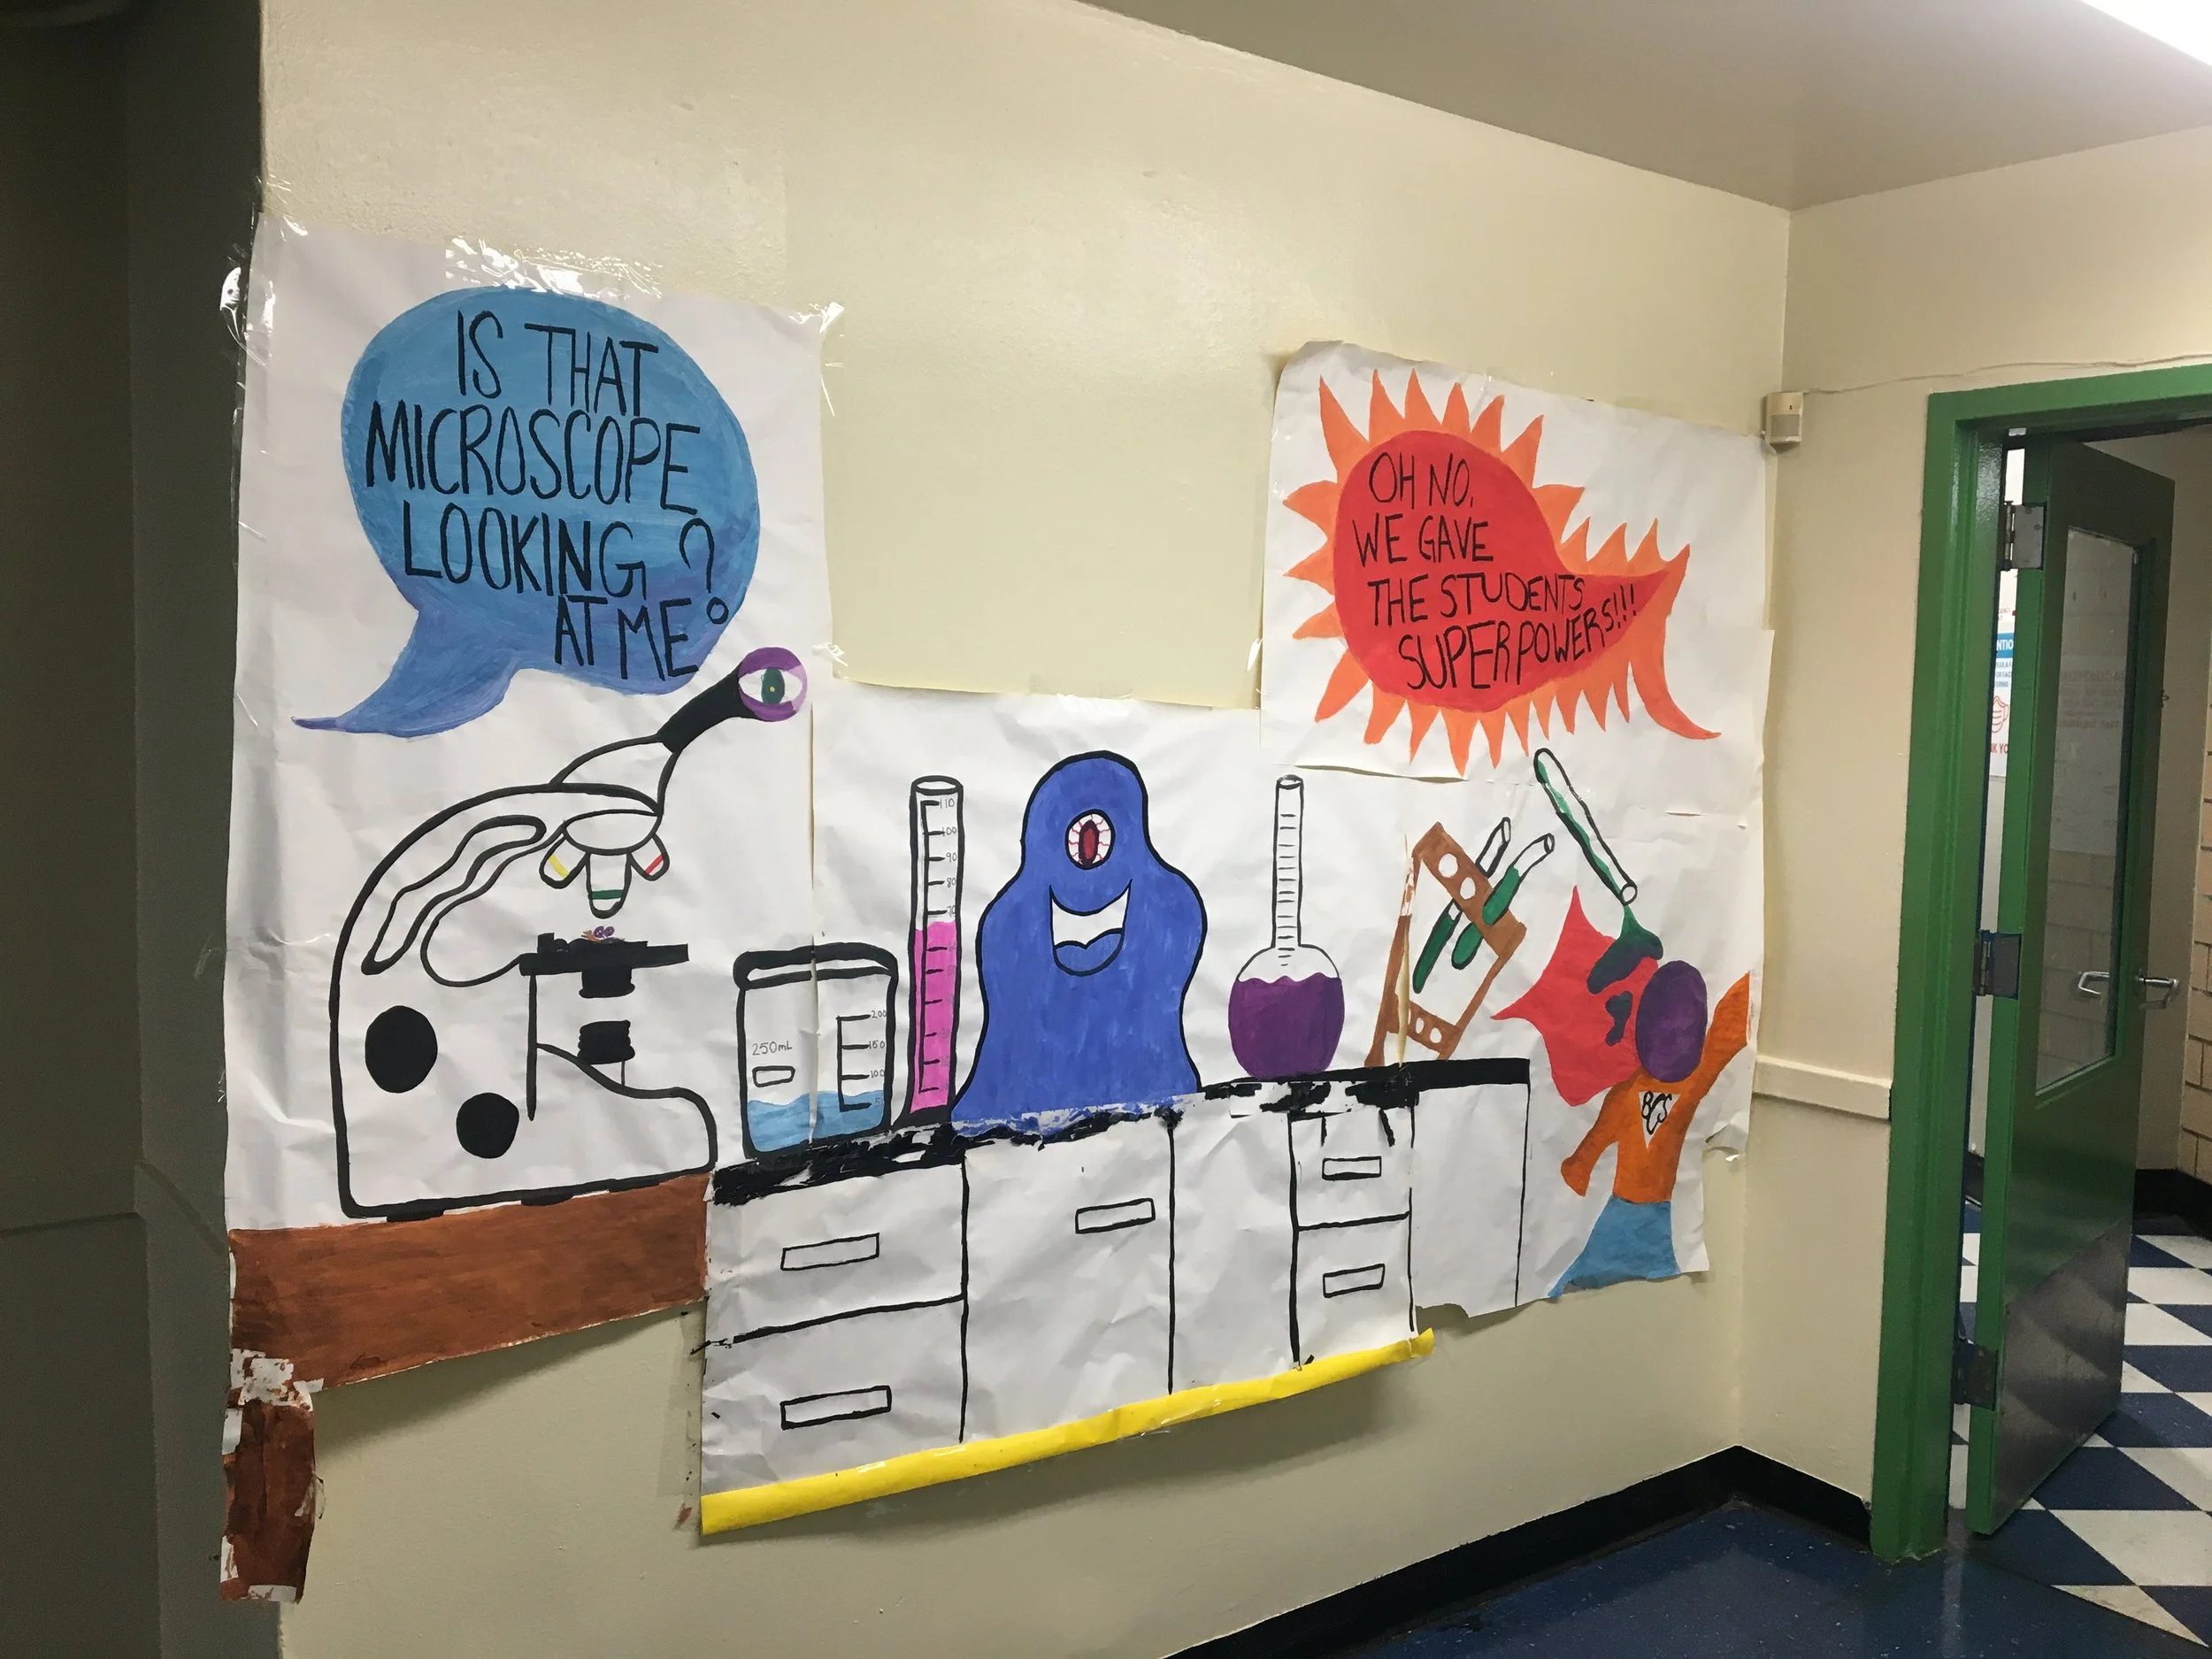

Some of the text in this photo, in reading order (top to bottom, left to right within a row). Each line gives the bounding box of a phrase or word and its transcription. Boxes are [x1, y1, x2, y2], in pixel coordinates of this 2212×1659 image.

[457, 309, 659, 417] IS THAT
[365, 398, 701, 516] MICROSCOPE
[1368, 451, 1416, 511] OH
[402, 499, 648, 601] LOOKING
[1352, 511, 1494, 568] WE GAVE
[1367, 571, 1586, 627] THE STUDENTS
[553, 593, 609, 667] AT
[939, 797, 956, 809] 110
[945, 851, 957, 863] 90
[946, 877, 956, 887] 80
